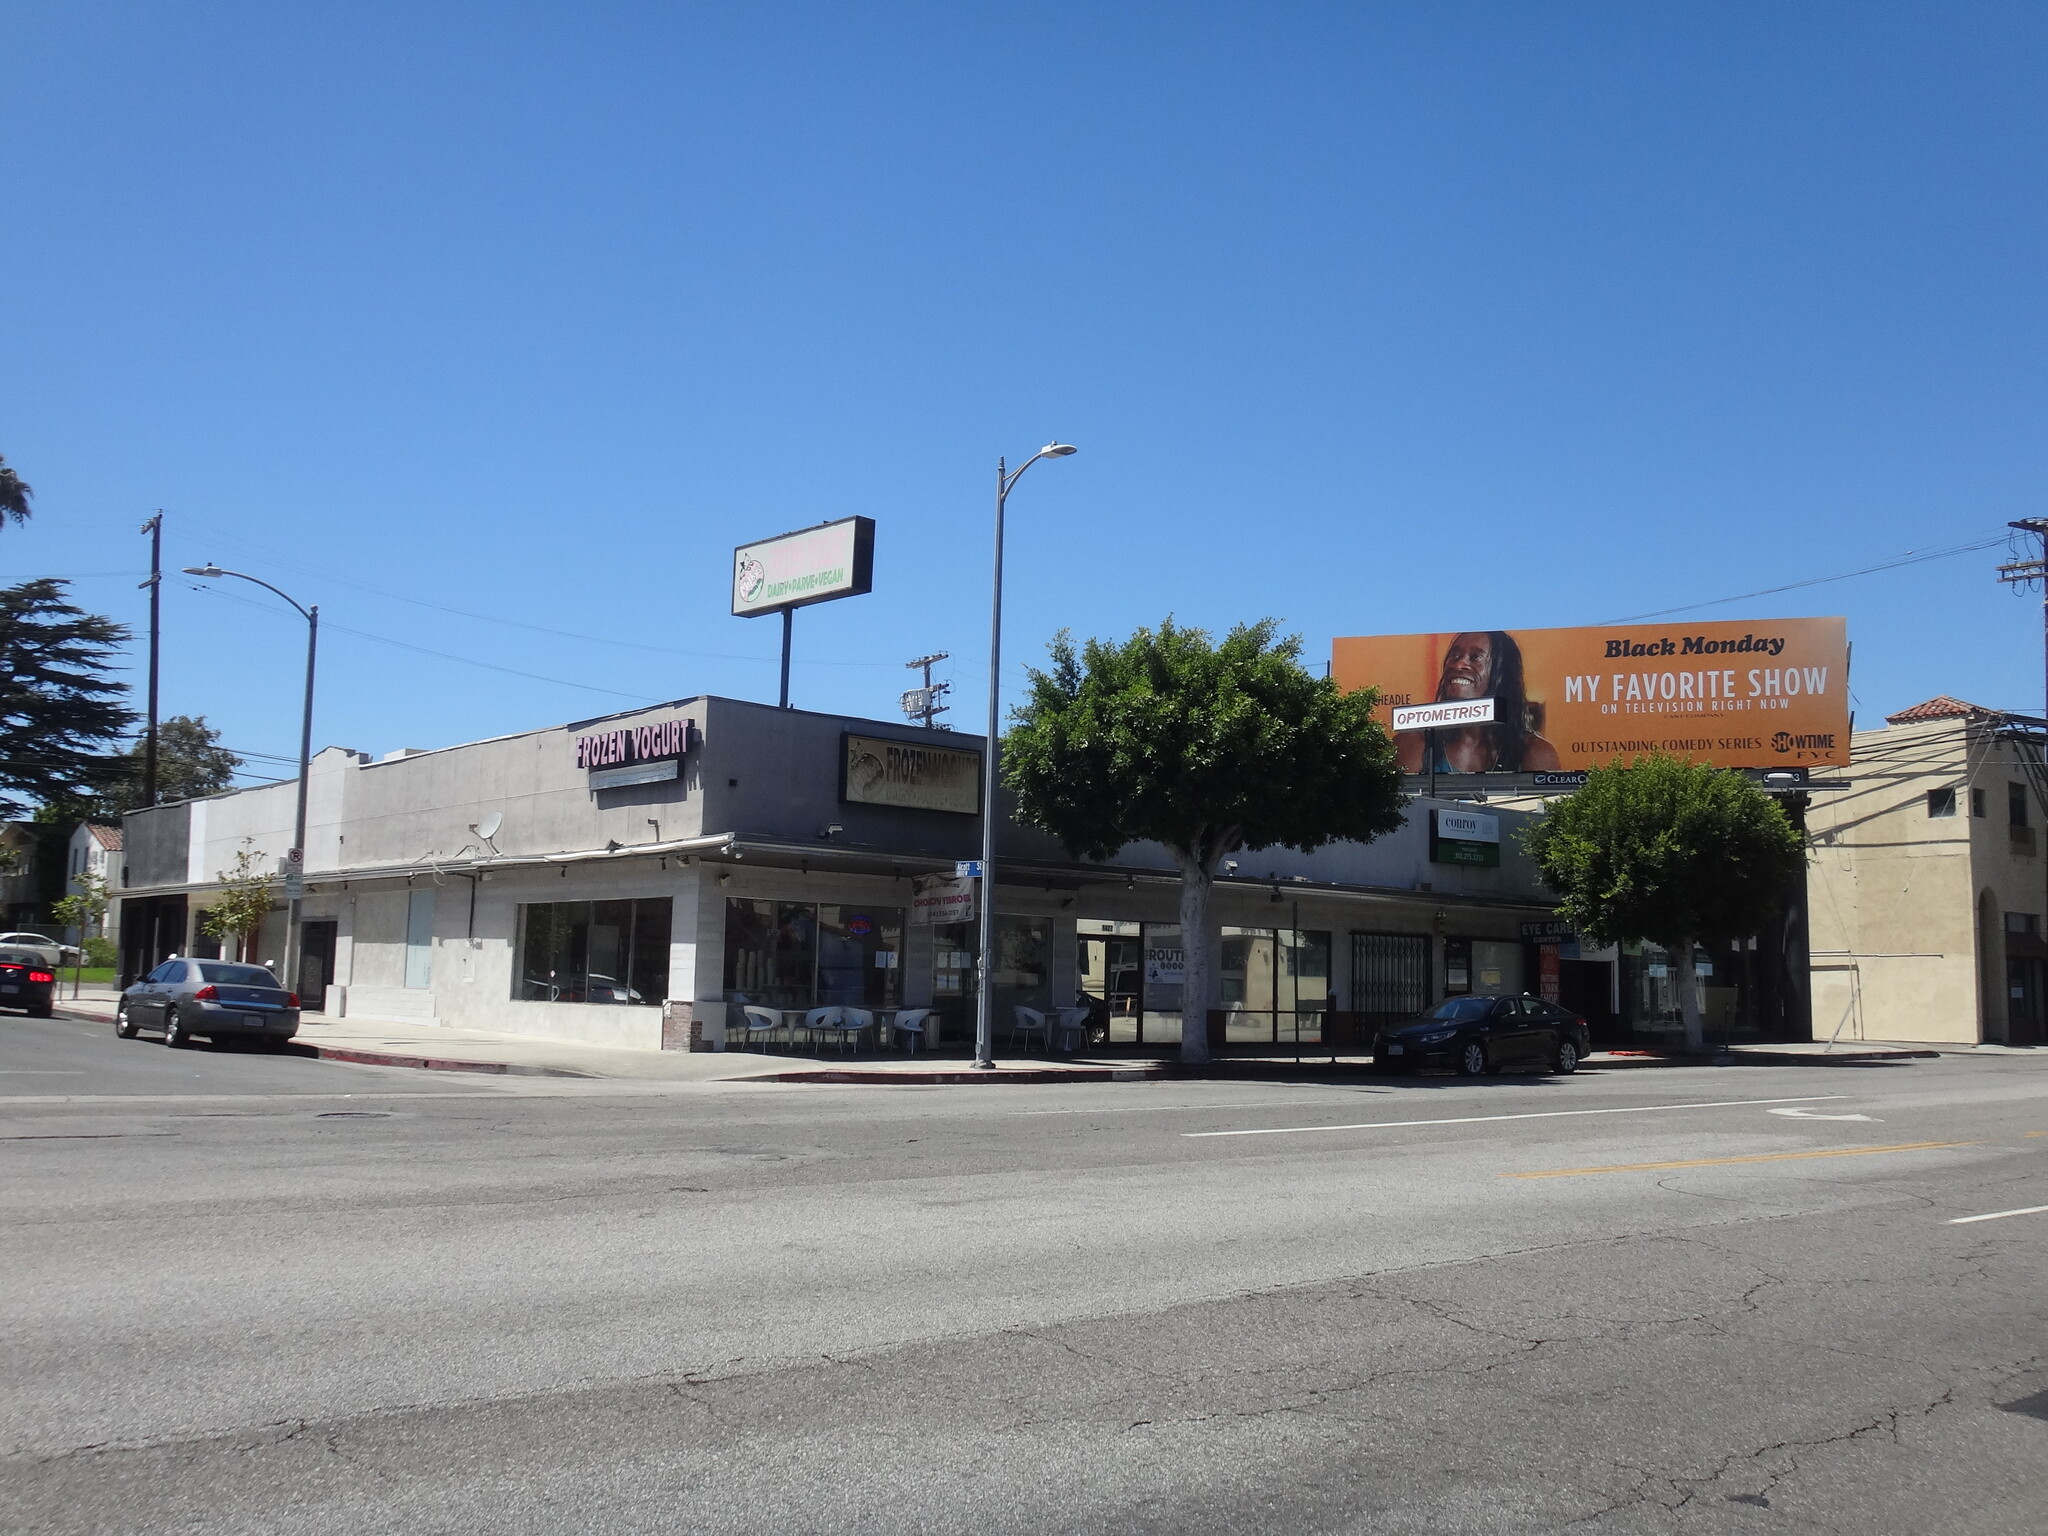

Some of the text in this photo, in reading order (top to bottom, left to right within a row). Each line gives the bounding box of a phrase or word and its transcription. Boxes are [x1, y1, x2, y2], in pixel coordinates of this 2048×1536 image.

[1604, 634, 1785, 658] Black Monday
[1565, 666, 1827, 703] MY FAVORITE SHOW
[1377, 694, 1411, 706] HEADLE
[1601, 698, 1790, 714] ON TELEVISION RIGHT NOW
[1397, 704, 1490, 725] OPTOMETRIST
[576, 720, 689, 769] FROZEN YOGURT
[1572, 737, 1762, 753] OUTSTANDING COMEDY SERIES
[1771, 731, 1835, 753] SHOWTIME
[887, 746, 931, 786] FROZEN
[957, 862, 983, 871] Alcott St
[1521, 923, 1573, 936] EYE CARE
[1533, 936, 1562, 944] CENTER
